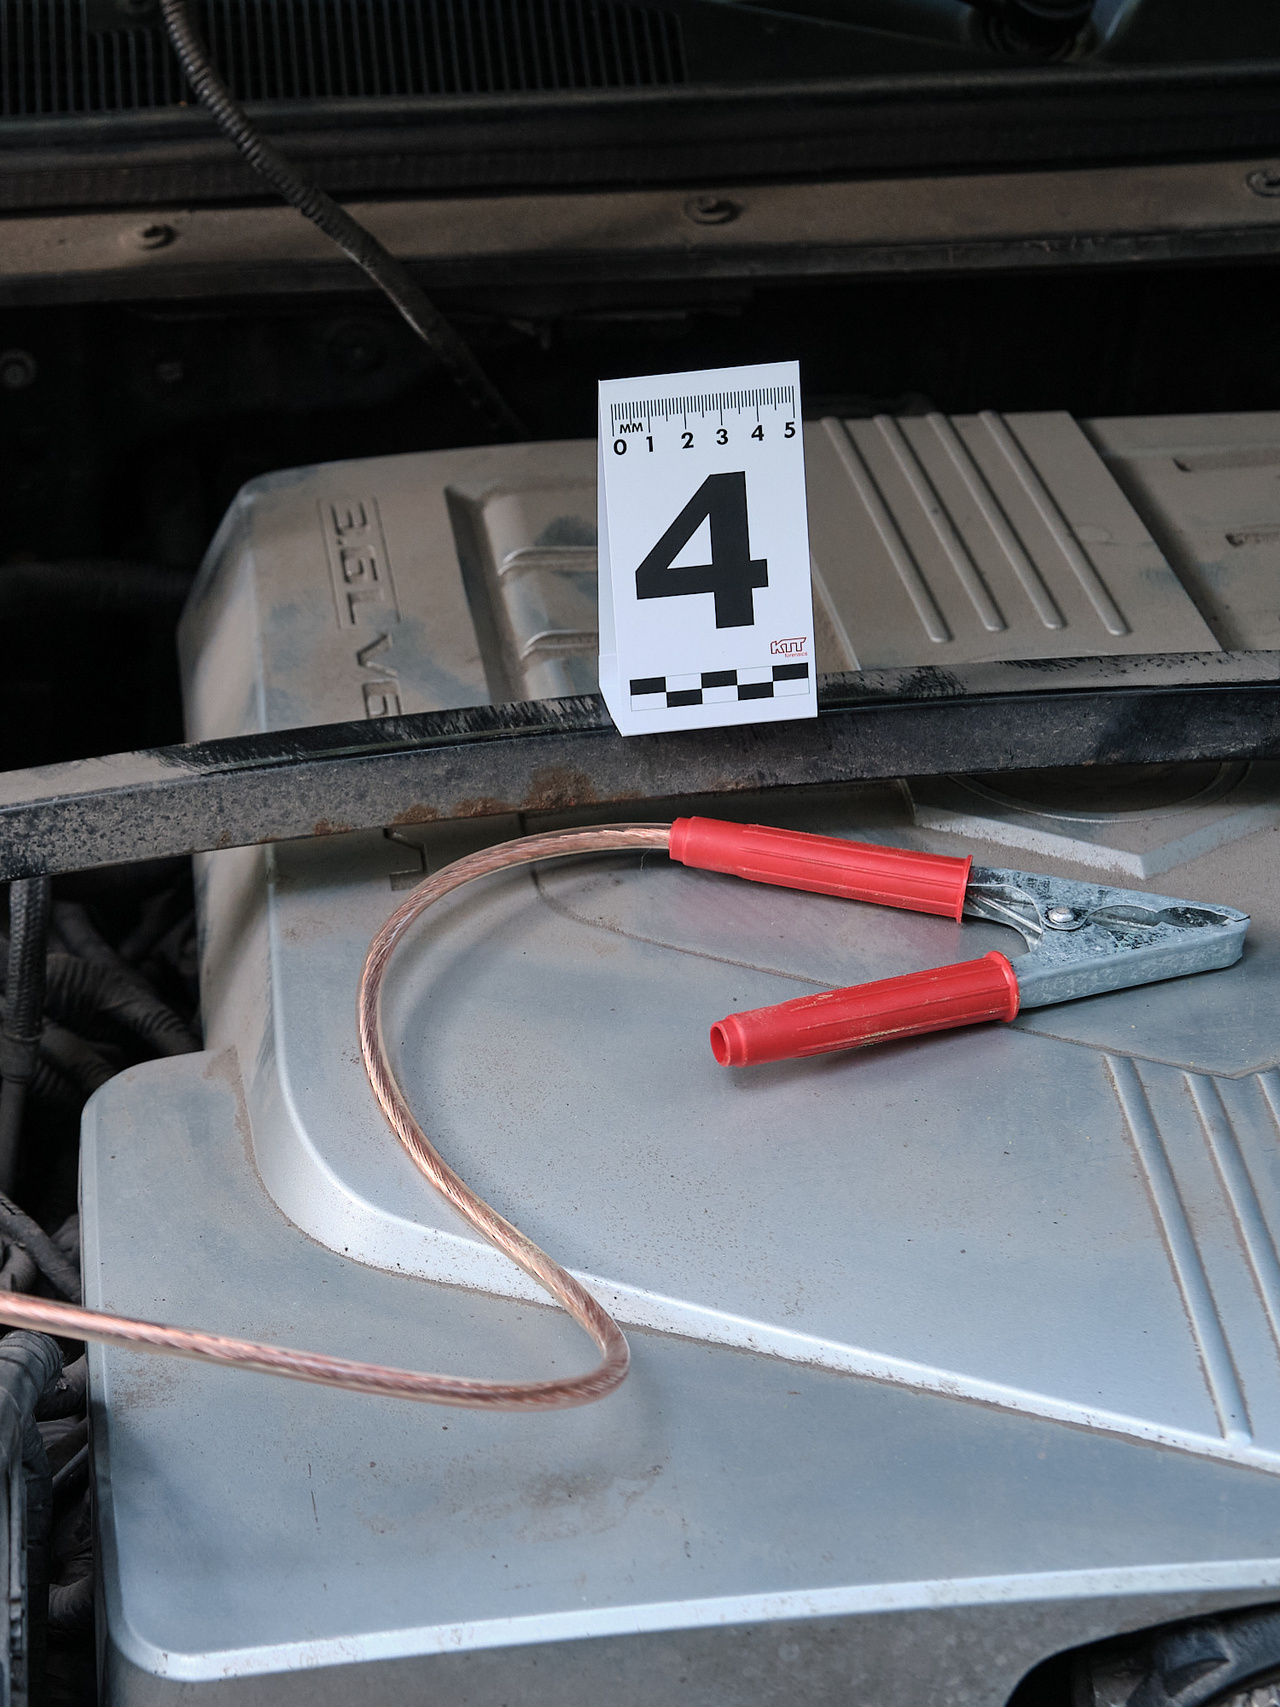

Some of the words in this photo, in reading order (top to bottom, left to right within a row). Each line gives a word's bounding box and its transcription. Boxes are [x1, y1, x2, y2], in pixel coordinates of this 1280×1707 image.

[613, 438, 627, 456] 0
[645, 435, 654, 452] 1
[680, 431, 695, 449] 2
[715, 428, 729, 446] 3
[751, 424, 765, 442] 4
[783, 421, 796, 439] 5
[619, 422, 643, 434] MM
[635, 470, 769, 629] 4
